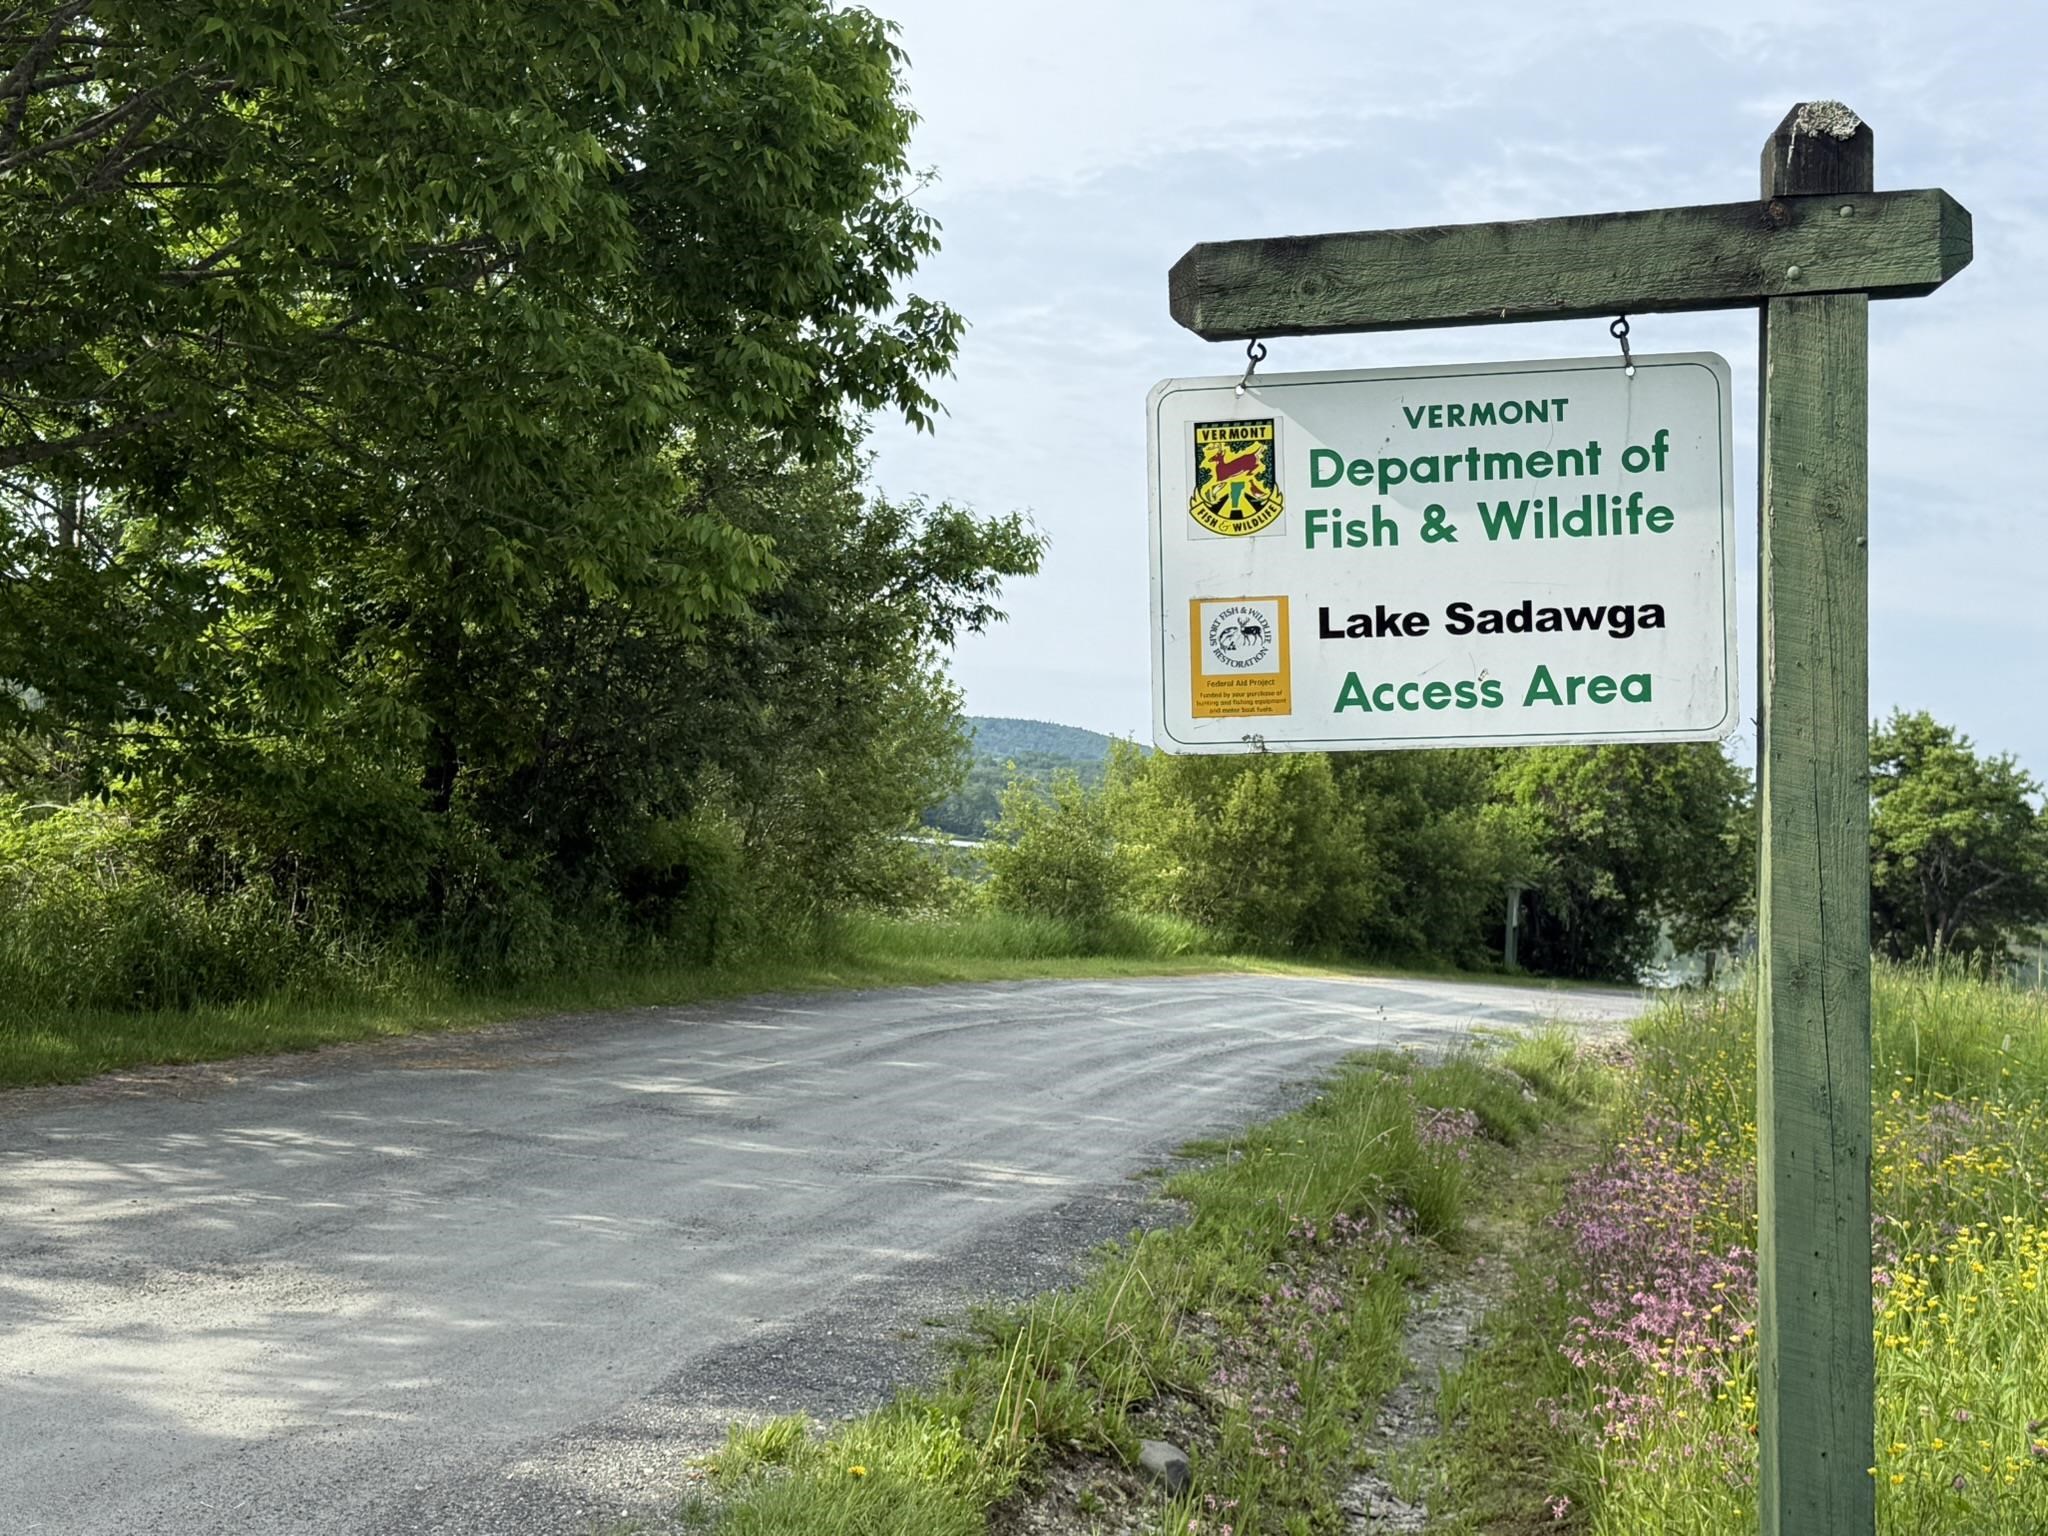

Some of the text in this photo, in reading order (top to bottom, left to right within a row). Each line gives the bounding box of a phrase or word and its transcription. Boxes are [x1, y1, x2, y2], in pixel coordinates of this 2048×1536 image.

[1402, 398, 1569, 429] VERMONT
[1202, 427, 1266, 441] VERMONT
[1309, 429, 1669, 495] Department of
[1197, 504, 1277, 532] FISH & WILDLIFE
[1304, 492, 1674, 549] Fish & Wildlife
[1210, 620, 1221, 646] SPORT
[1219, 607, 1238, 620] FISH
[1249, 608, 1272, 644] WILDLIFE
[1319, 600, 1665, 639] Lake Sadawga
[1213, 647, 1269, 668] RESTORATION
[1249, 679, 1275, 687] Project
[1334, 665, 1653, 713] Access Area
